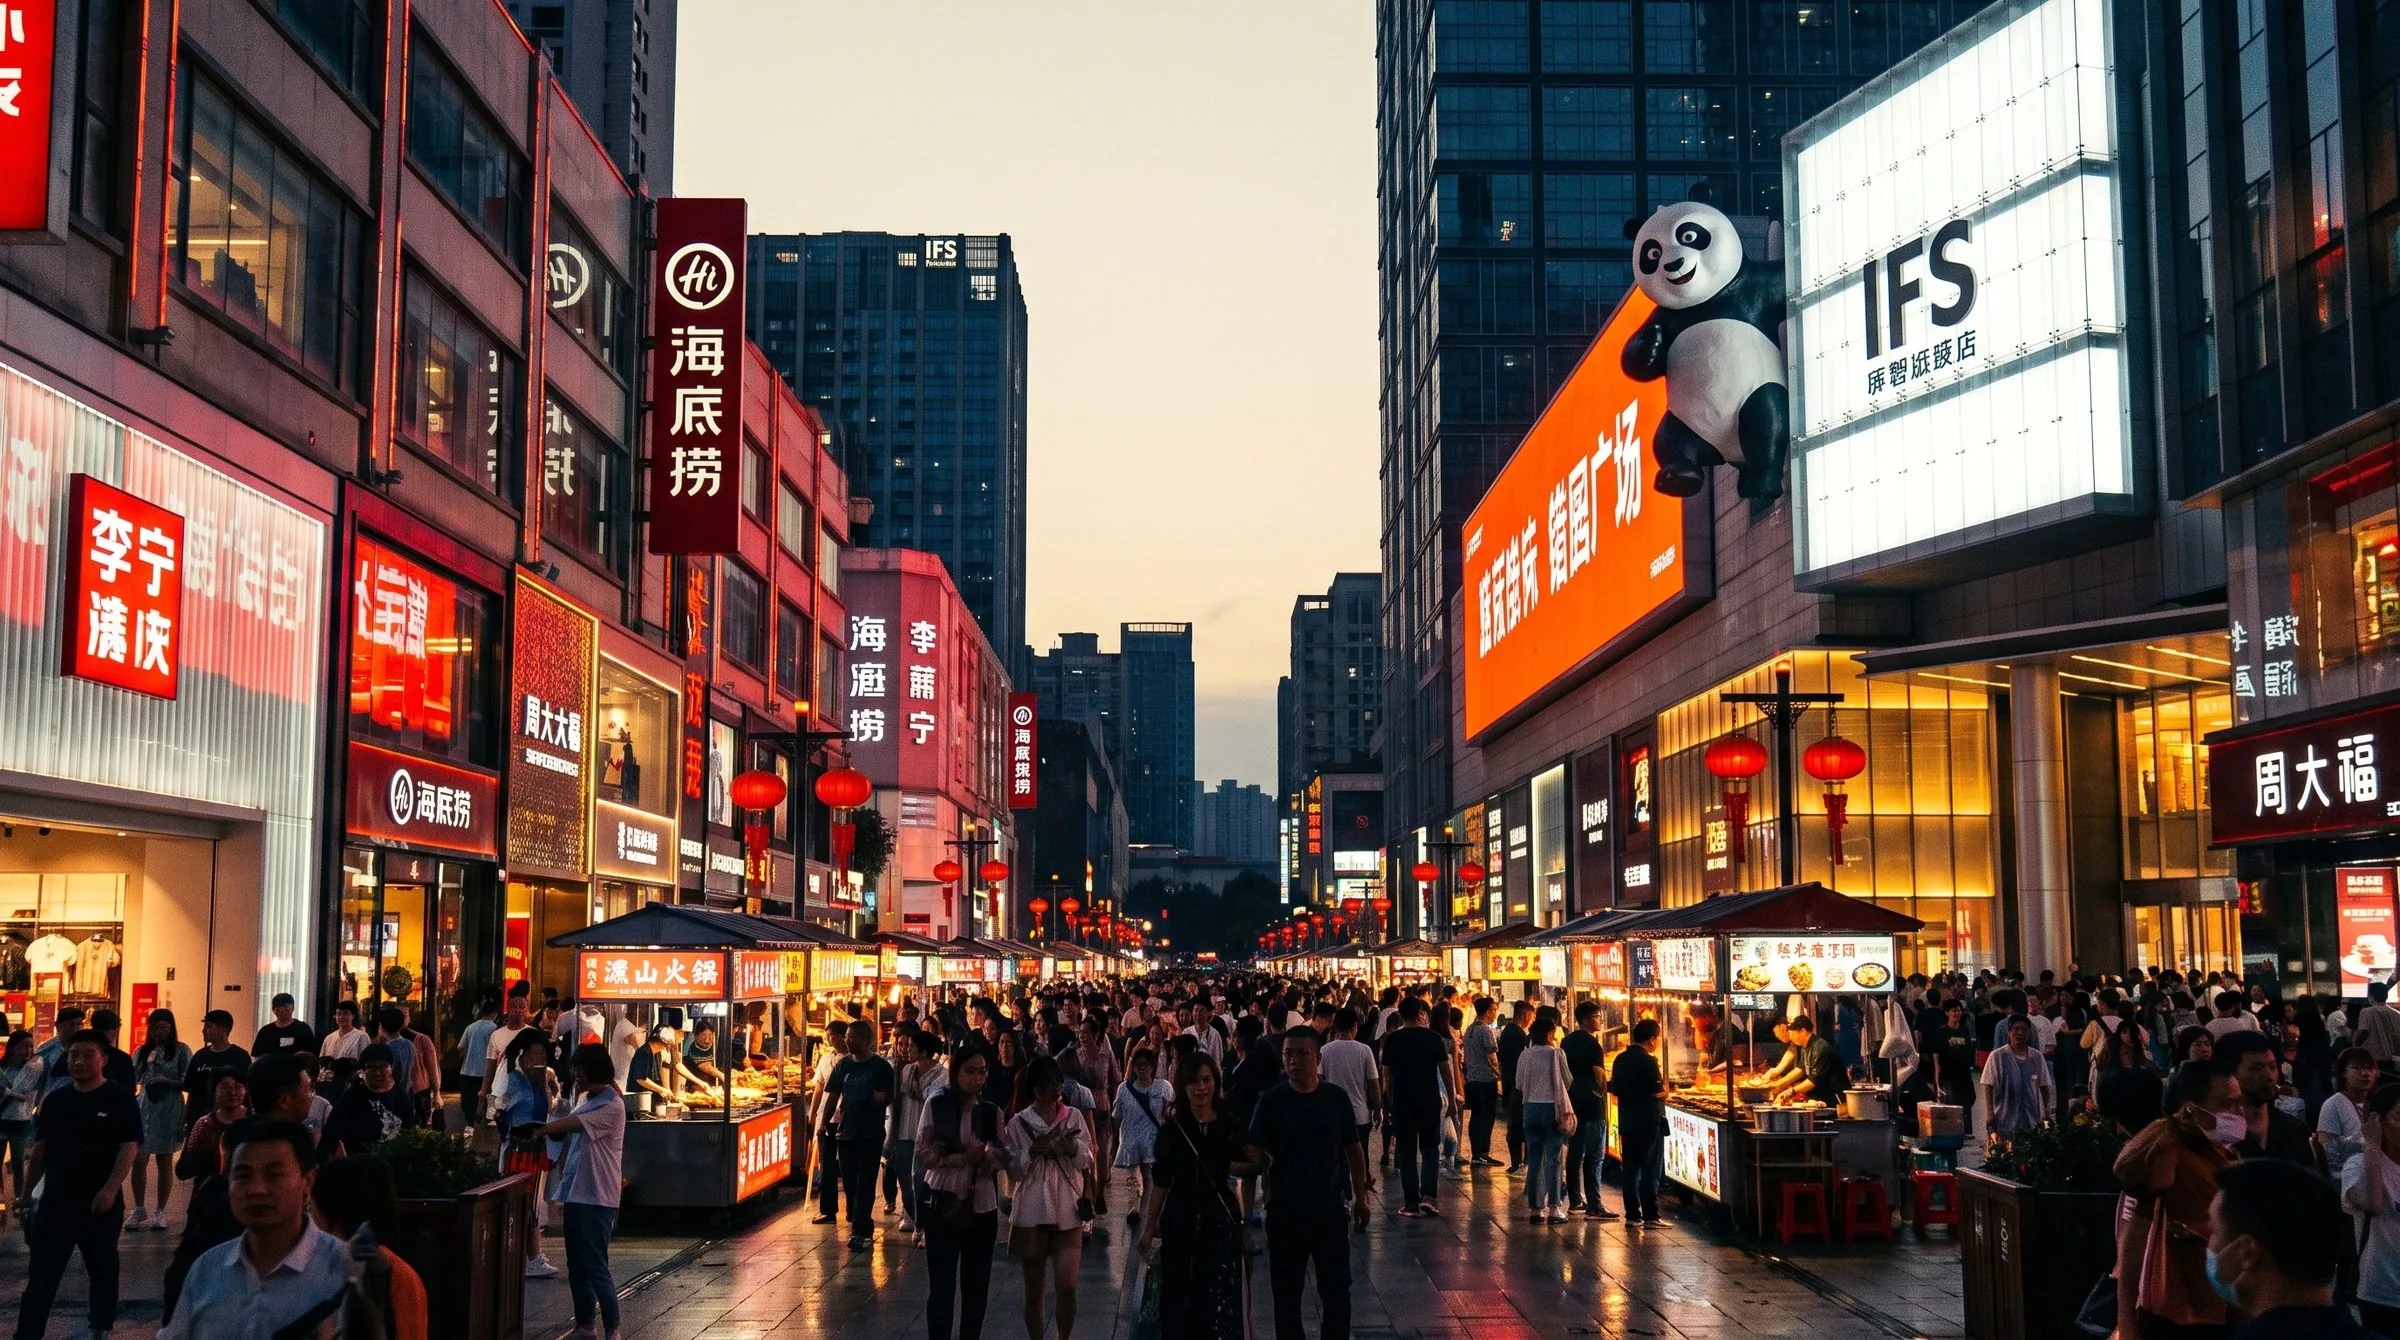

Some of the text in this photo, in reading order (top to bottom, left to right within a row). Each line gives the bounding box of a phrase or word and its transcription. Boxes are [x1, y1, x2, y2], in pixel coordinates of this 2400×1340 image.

[925, 240, 957, 259] IFS
[1863, 219, 1977, 361] IFS
[670, 325, 724, 497] 海底捞
[91, 508, 175, 597] 李宁
[415, 780, 471, 829] 海底捞
[2255, 733, 2378, 817] 周大福
